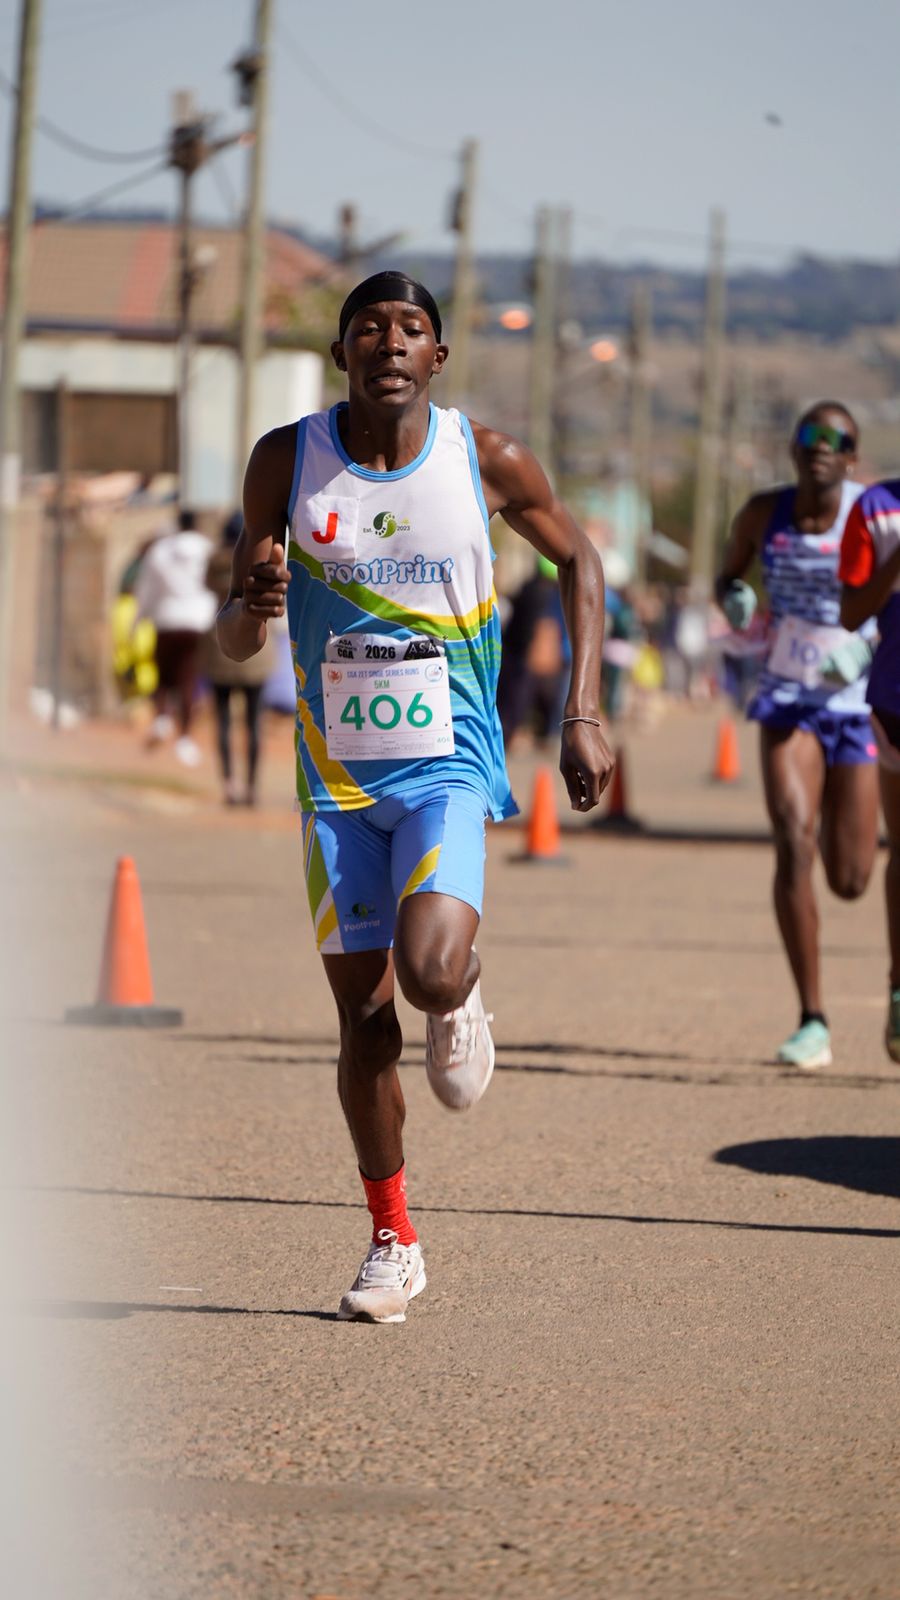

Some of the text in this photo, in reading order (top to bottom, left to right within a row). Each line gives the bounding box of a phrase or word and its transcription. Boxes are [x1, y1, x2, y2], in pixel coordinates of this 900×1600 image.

[311, 512, 338, 545] J
[322, 554, 453, 585] FootPrint
[365, 644, 396, 660] 2026
[409, 642, 437, 654] ASA
[373, 680, 390, 689] 5KM
[340, 691, 433, 731] 406
